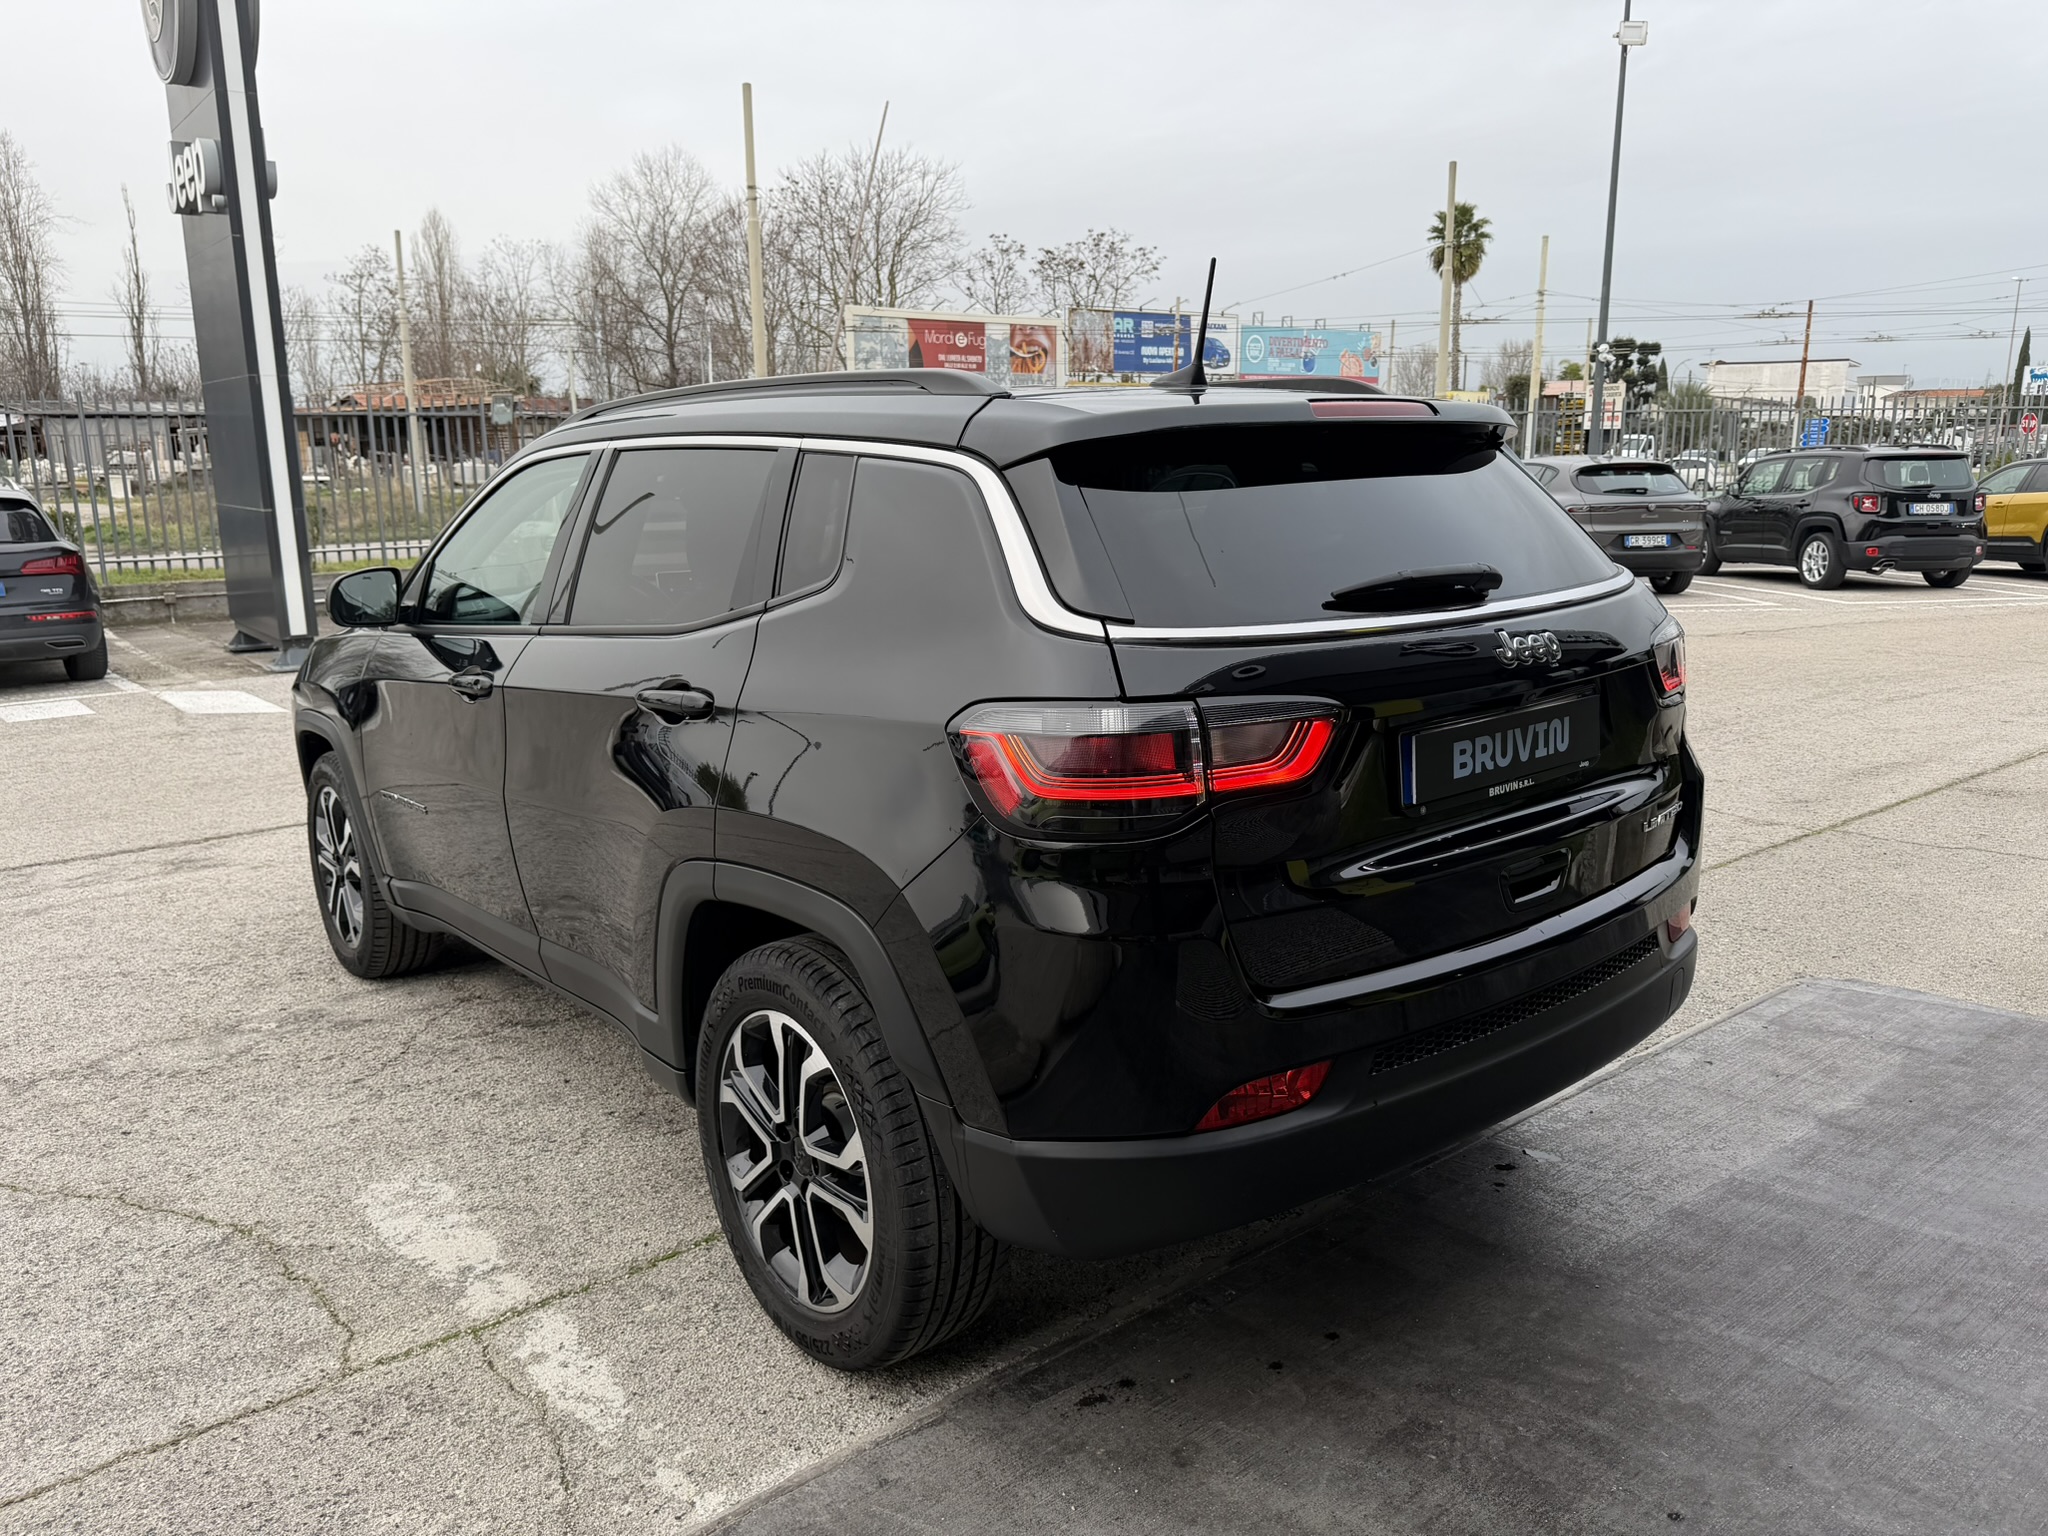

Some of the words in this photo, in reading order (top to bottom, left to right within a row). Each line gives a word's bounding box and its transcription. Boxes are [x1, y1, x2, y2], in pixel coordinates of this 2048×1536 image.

[166, 137, 222, 214] Jeep
[1494, 628, 1562, 668] Jeep
[1453, 716, 1570, 780] BRUVIN
[1489, 780, 1519, 797] BRUVIN
